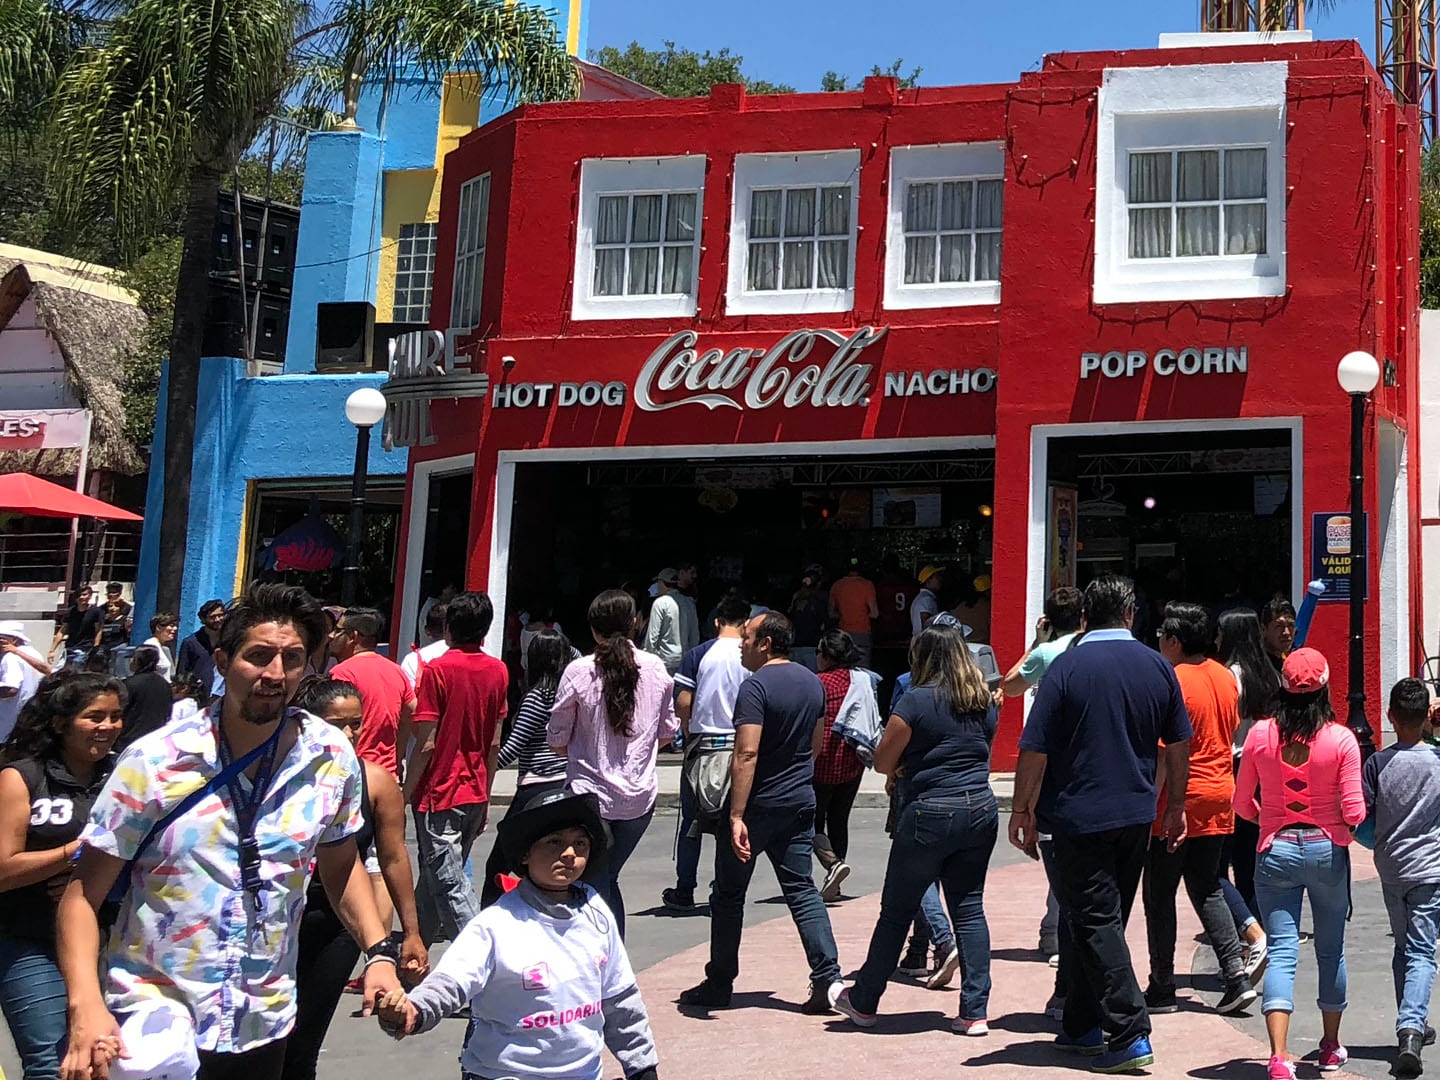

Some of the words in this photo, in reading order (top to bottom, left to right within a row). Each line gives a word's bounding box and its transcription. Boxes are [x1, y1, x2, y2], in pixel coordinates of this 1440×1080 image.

[634, 323, 889, 411] Coca-Cola
[1080, 351, 1148, 379] POP
[1152, 346, 1248, 376] CORN
[492, 382, 554, 408] HOT
[558, 381, 627, 407] DOG
[0, 418, 36, 438] ES
[1321, 556, 1351, 566] VÁLID
[894, 591, 905, 611] 9
[30, 798, 74, 826] 33
